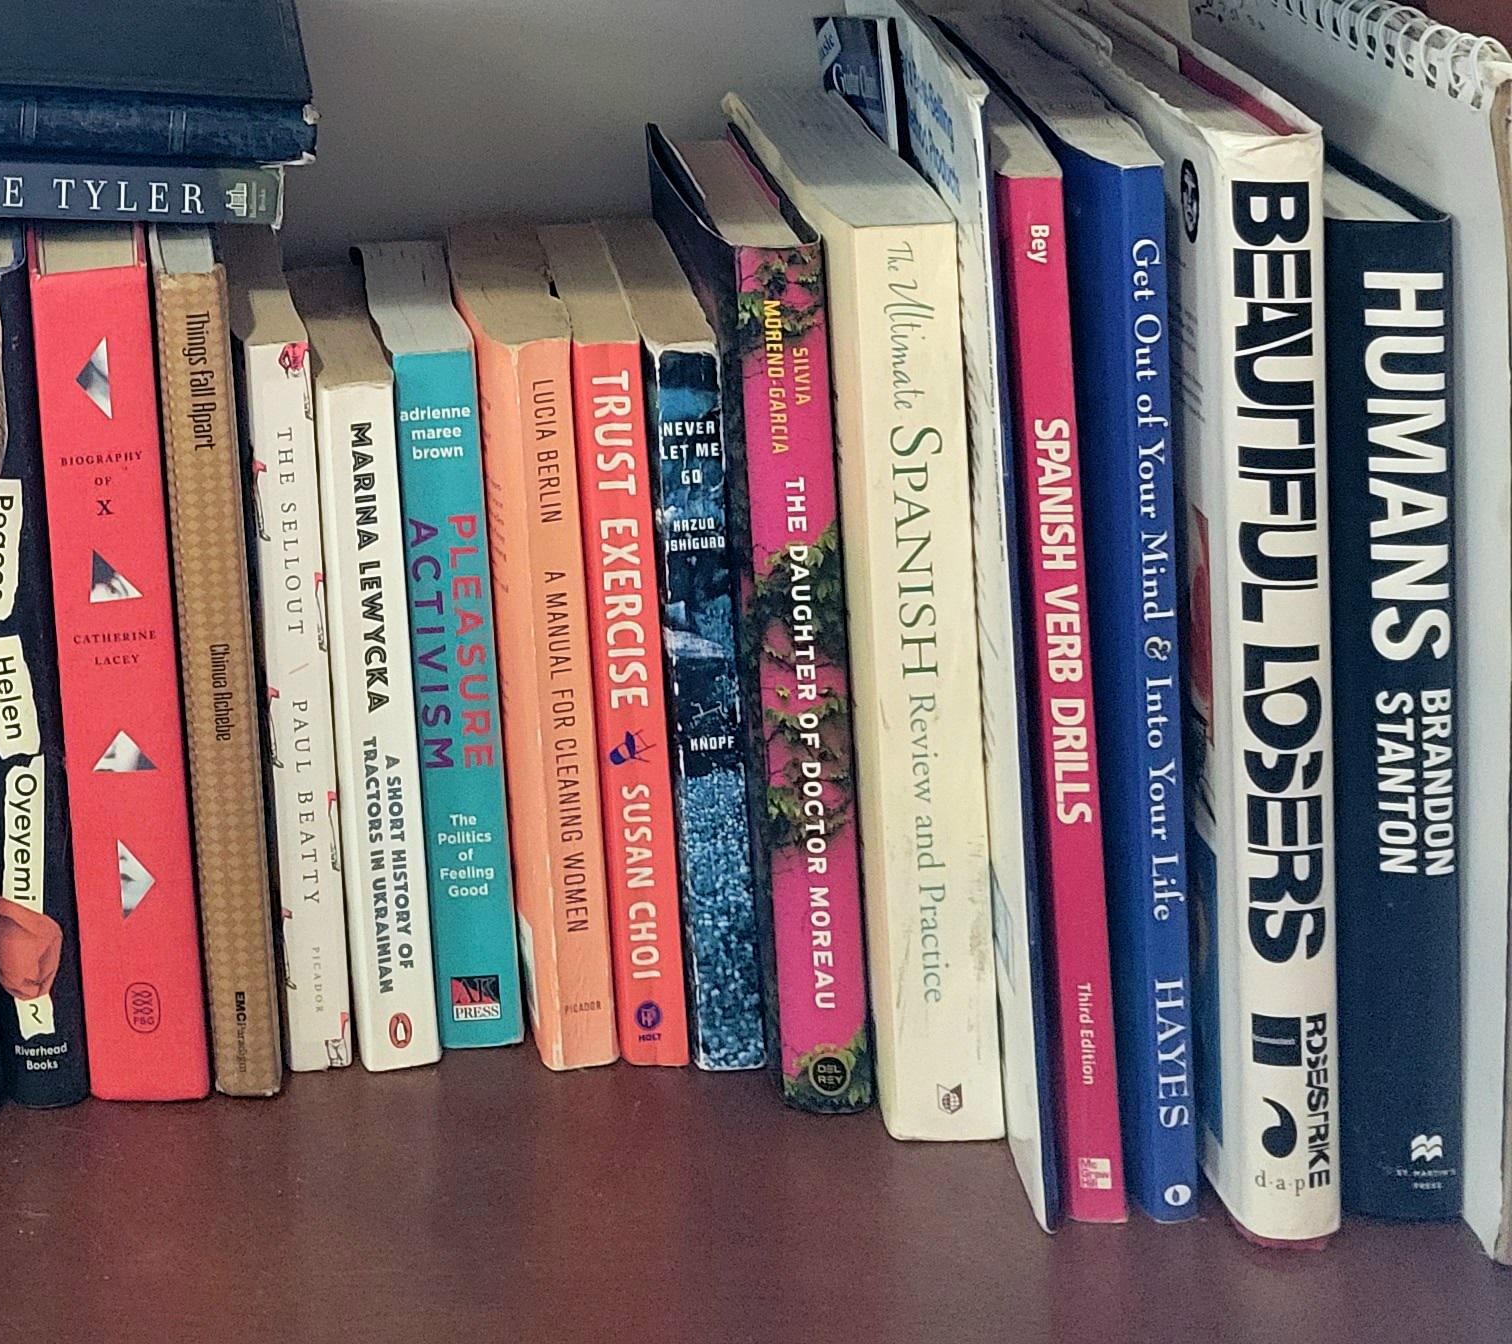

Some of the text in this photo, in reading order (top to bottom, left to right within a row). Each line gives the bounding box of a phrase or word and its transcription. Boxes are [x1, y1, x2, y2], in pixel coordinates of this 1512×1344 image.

[54, 179, 204, 214] TYLER
[59, 451, 144, 467] BIOGRAPHY
[94, 476, 113, 487] OF
[96, 500, 115, 515] X
[533, 379, 564, 523] LUCIA BERLIN
[1364, 272, 1451, 661] HUMANS
[72, 630, 158, 646] CATHERINE
[351, 423, 390, 712] MARINA LEWYCKA
[94, 655, 140, 667] LACEY
[593, 370, 660, 979] TRUST EXERCISE SUSAN CHOI
[1026, 224, 1097, 1084] Bey SPANISH VERB DRILLS Third Edition
[7, 773, 37, 903] Oyeyemi
[292, 700, 320, 904] PAUL BEATTY
[1377, 691, 1417, 873] STANTON
[1420, 689, 1454, 876] BRANDON
[1154, 978, 1189, 1129] HAYES
